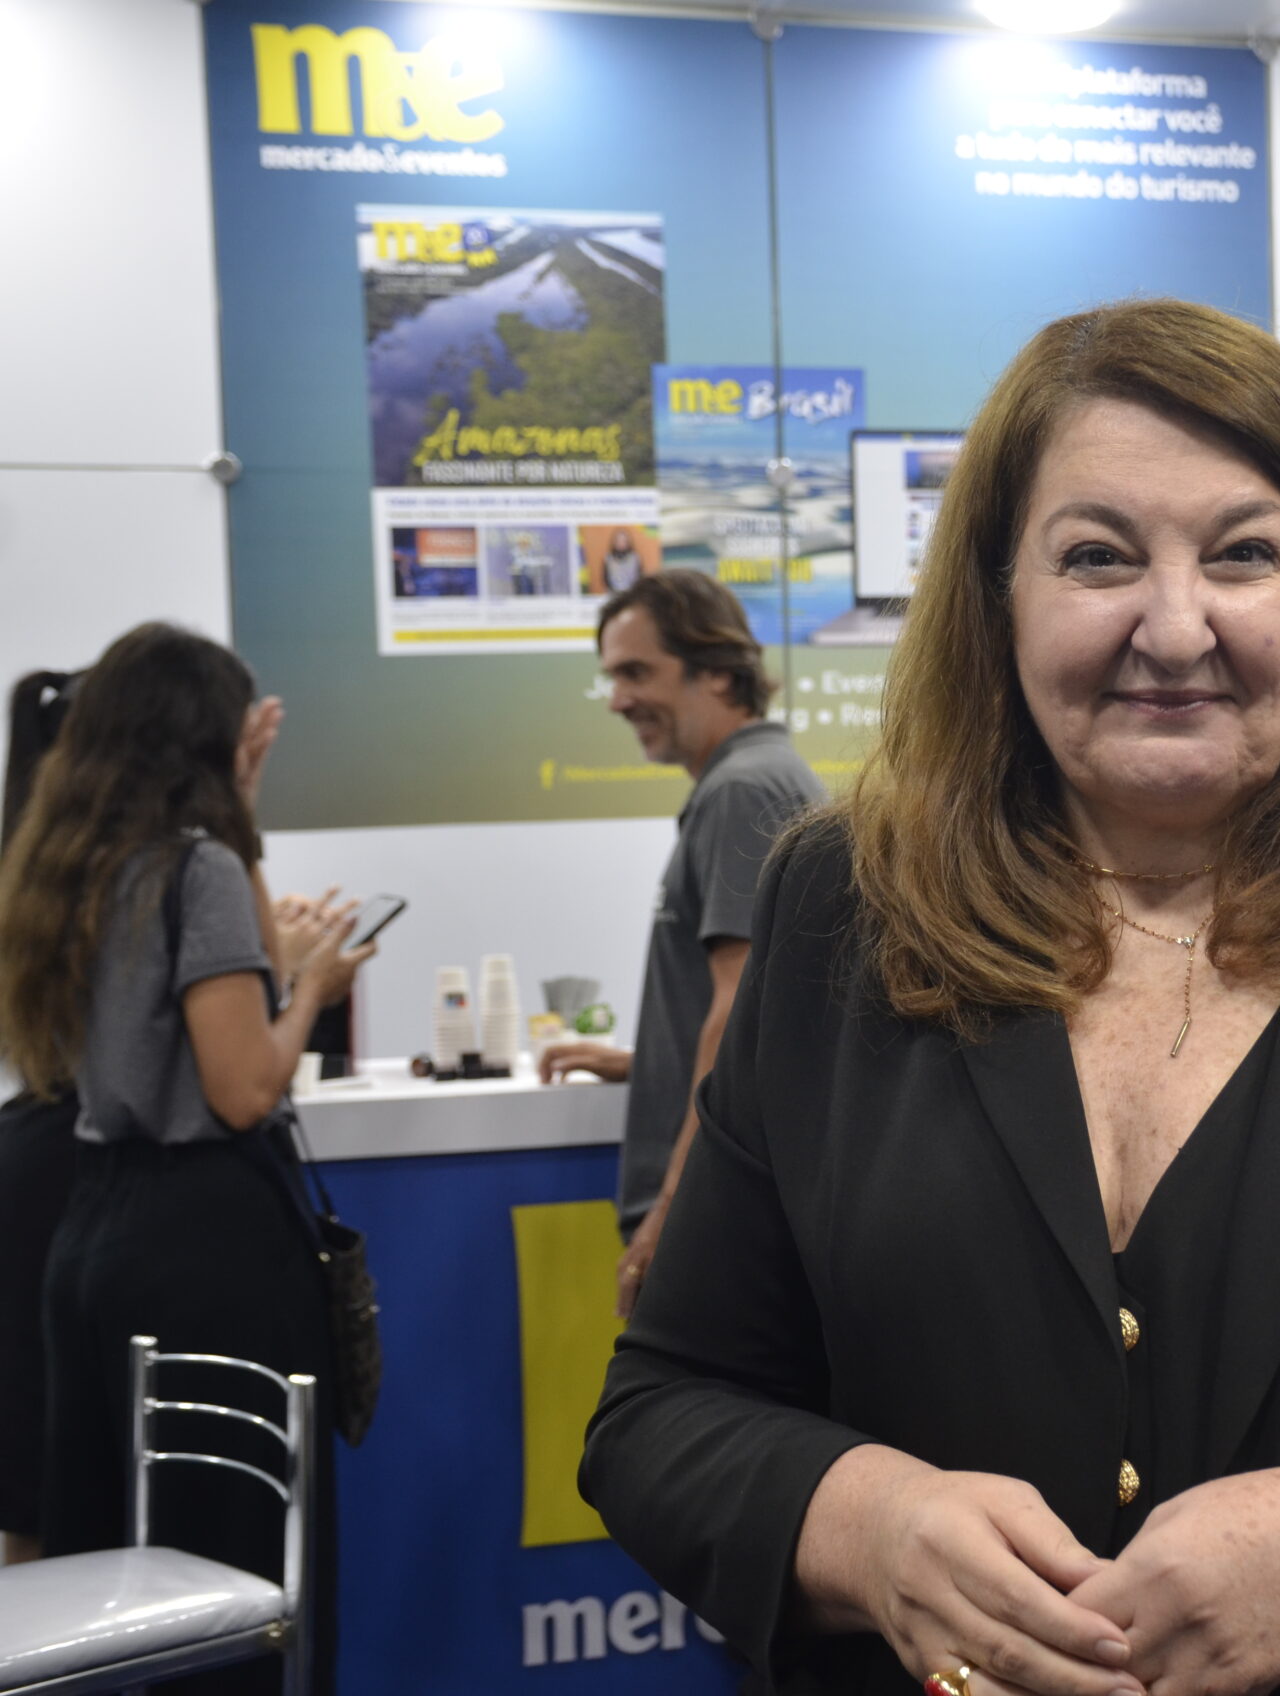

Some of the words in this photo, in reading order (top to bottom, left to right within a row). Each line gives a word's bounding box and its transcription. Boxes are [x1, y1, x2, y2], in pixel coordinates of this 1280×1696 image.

[1166, 101, 1225, 134] você
[1074, 134, 1139, 166] mais
[1139, 137, 1257, 170] relevante
[975, 171, 1010, 196] no
[1011, 167, 1104, 199] mundo
[1104, 169, 1140, 200] do
[1140, 171, 1240, 204] turismo
[413, 407, 622, 467] Amazonas
[551, 459, 625, 484] NATUREZA
